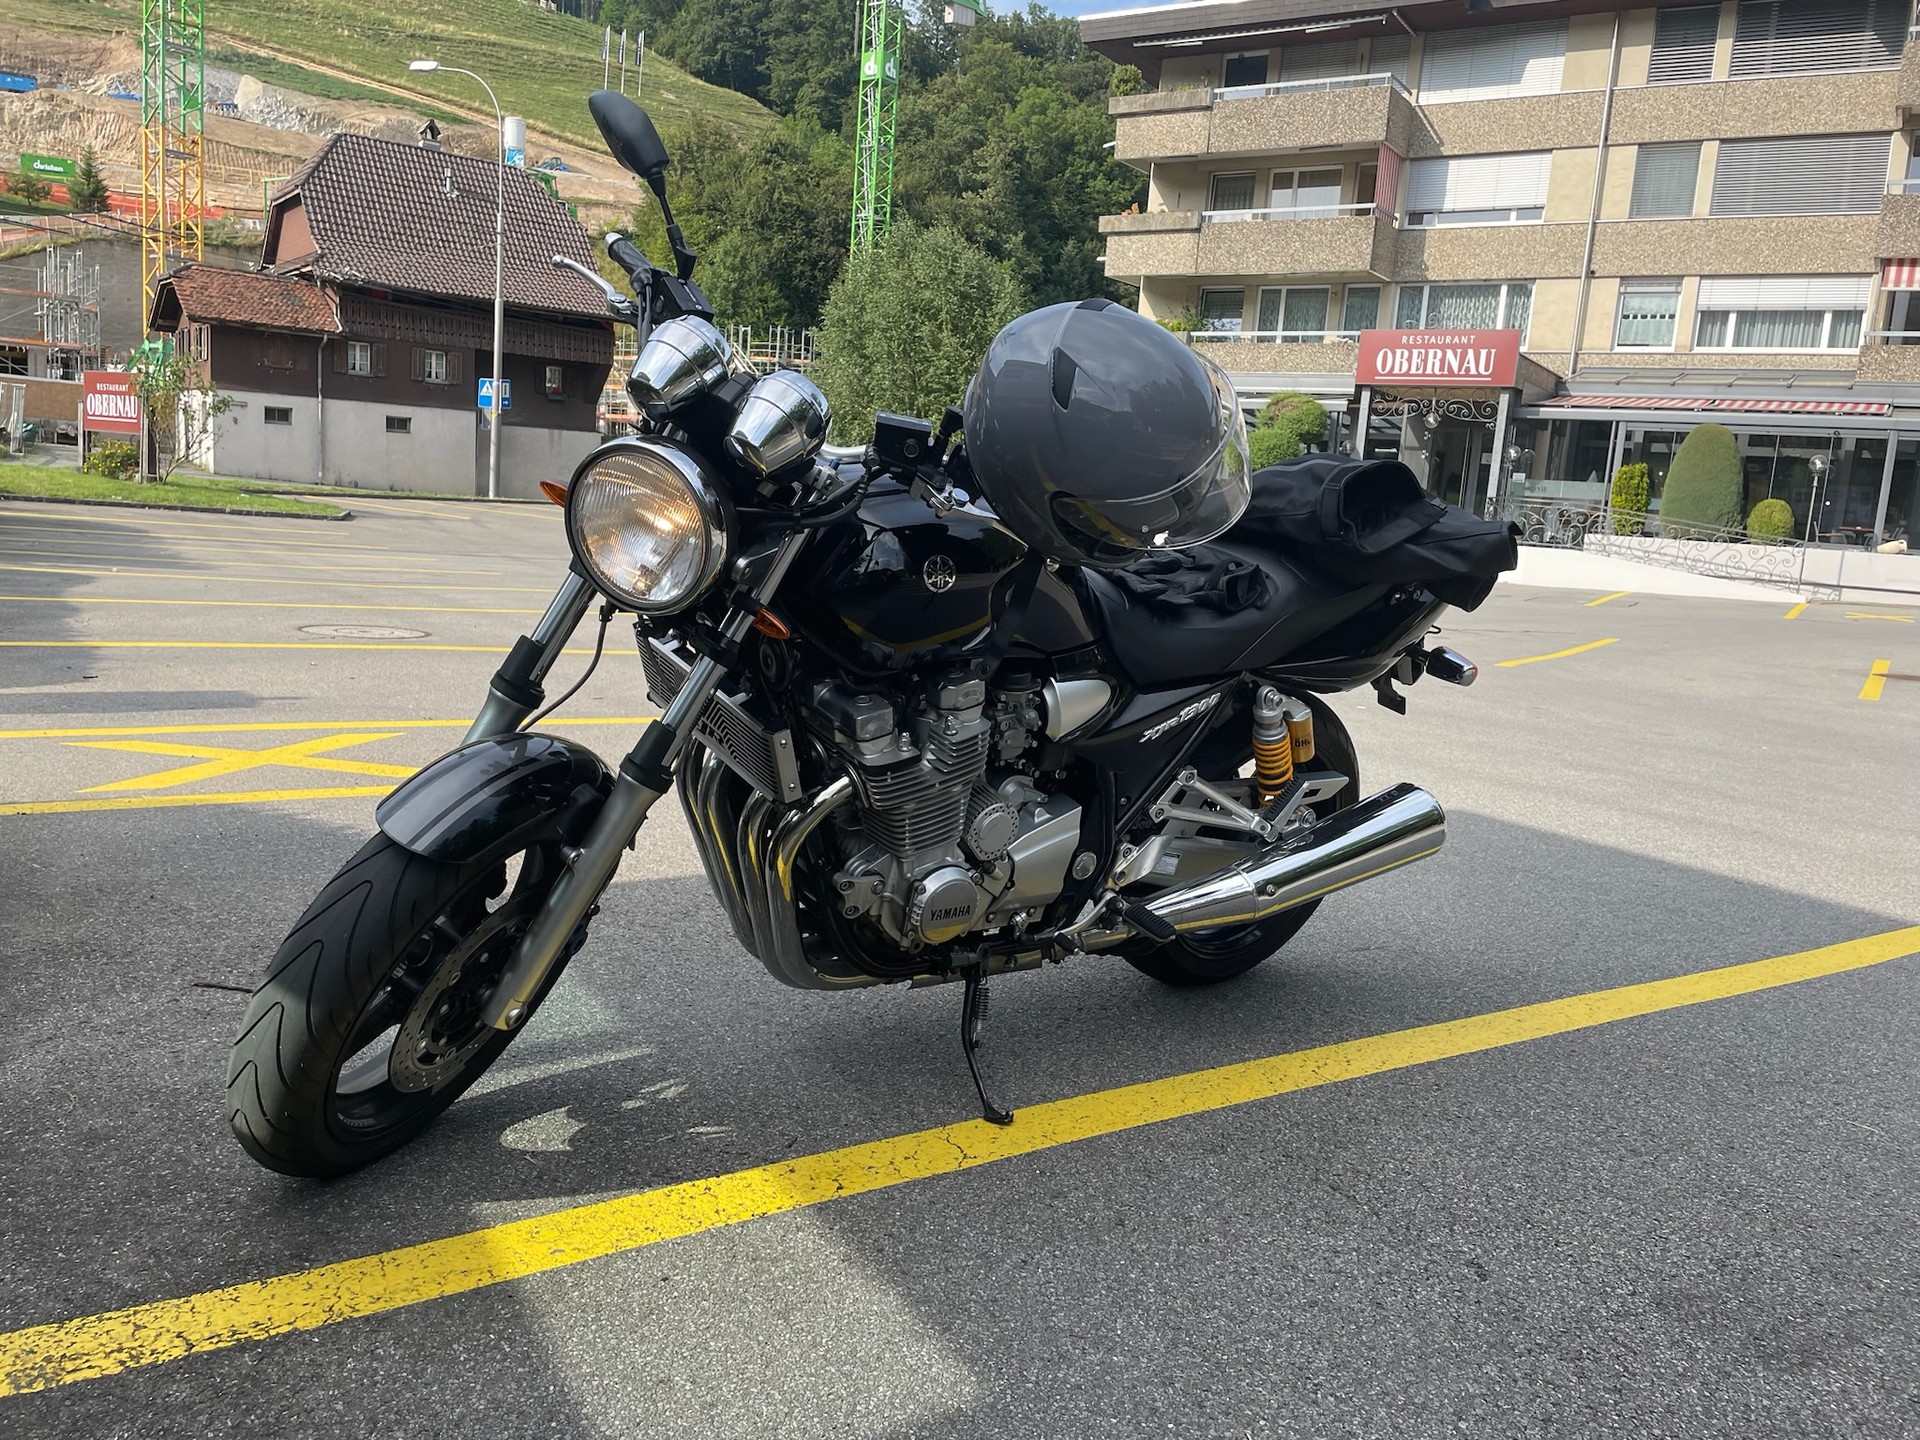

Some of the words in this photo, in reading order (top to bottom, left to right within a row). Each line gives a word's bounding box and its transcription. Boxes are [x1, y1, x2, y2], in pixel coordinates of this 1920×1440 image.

[1401, 335, 1476, 345] RESTAURANT
[1376, 348, 1497, 375] OBERNAU
[96, 382, 129, 392] RESTAURANT
[87, 393, 138, 418] OBERNAU
[930, 904, 971, 921] YAMAHA
